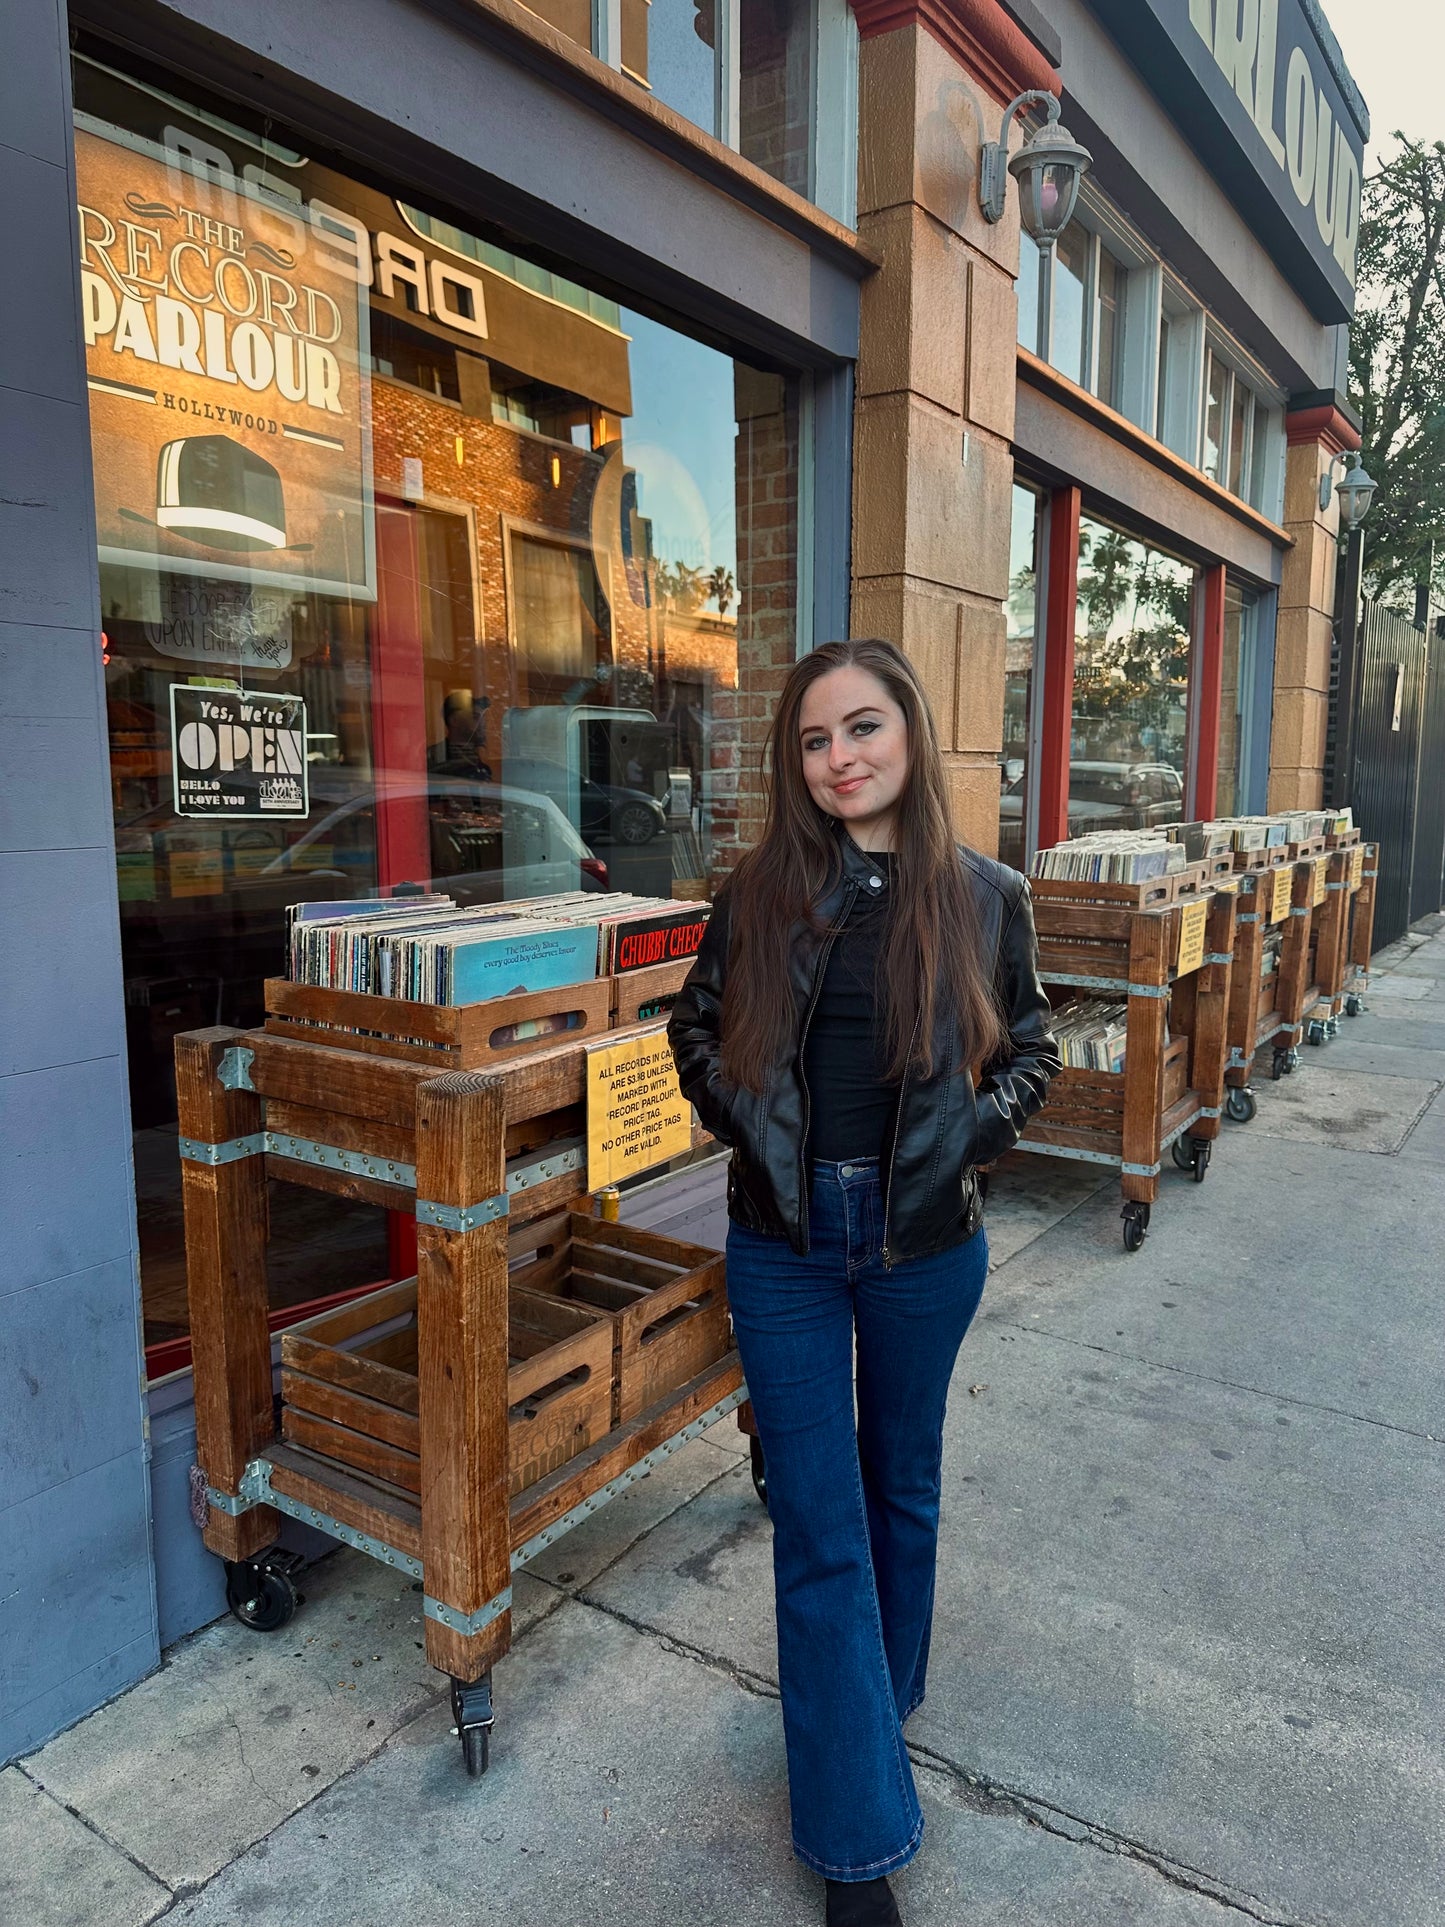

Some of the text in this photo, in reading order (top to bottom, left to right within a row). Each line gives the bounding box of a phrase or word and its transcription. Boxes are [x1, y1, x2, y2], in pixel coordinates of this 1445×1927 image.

[179, 206, 246, 258] THE
[78, 204, 342, 344] RECORD
[80, 269, 344, 415] PARLOUR
[162, 391, 278, 435] HOLLYWOOD
[200, 701, 283, 724] Yes, We're
[179, 722, 302, 774] OPEN
[180, 780, 220, 790] HELLO
[181, 795, 245, 805] I LOVE YOU
[503, 955, 519, 965] good
[505, 946, 519, 955] The
[620, 928, 670, 968] CHUBBY
[599, 1067, 614, 1080] ALL
[615, 1055, 651, 1075] RECORDS
[652, 1053, 660, 1063] IN
[610, 1077, 626, 1091] ARE
[646, 1061, 674, 1078] UNLESS
[617, 1077, 667, 1103] MARKED WITH
[641, 1087, 677, 1108] PARLOUR"
[624, 1108, 662, 1129] PRICE TAG.
[602, 1113, 682, 1152] NO OTHER PRICE TAGS
[624, 1135, 662, 1158] ARE VALID.
